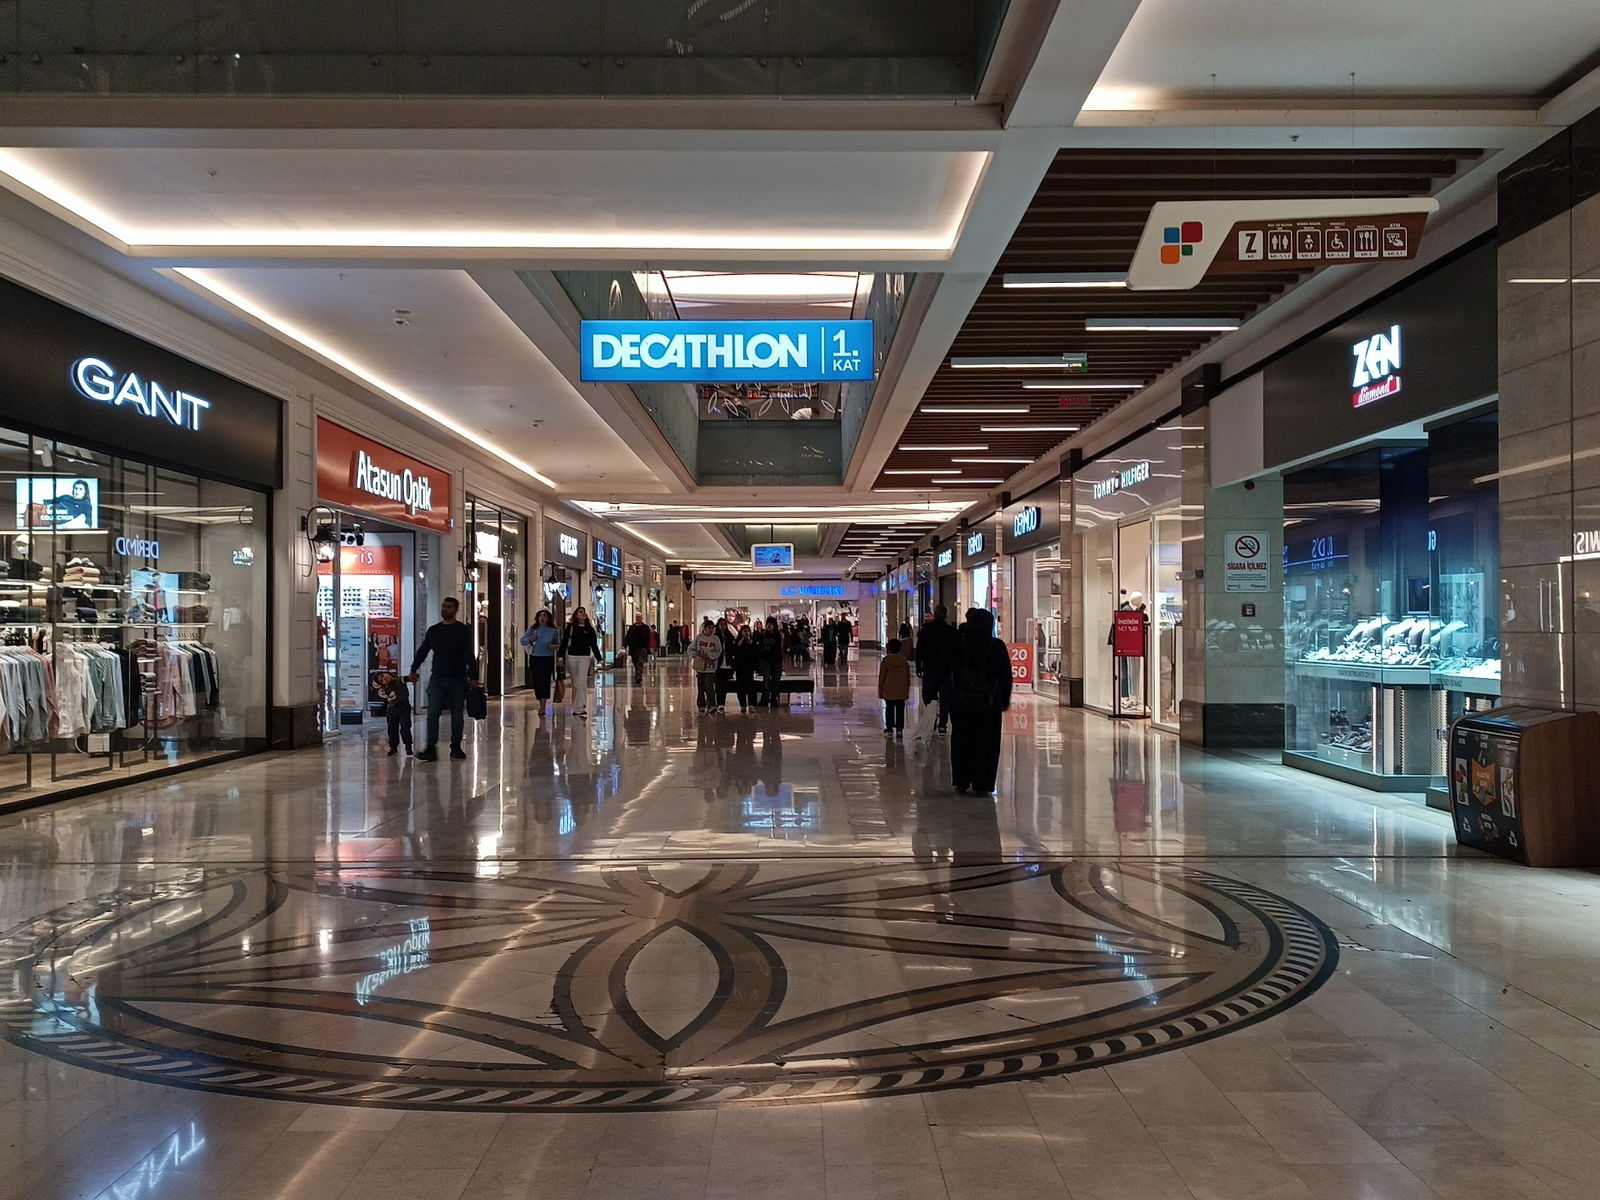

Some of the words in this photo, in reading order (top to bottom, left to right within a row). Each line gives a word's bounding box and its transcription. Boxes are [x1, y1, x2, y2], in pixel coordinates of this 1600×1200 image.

[1245, 233, 1257, 254] Z
[592, 333, 808, 369] DECATHLON
[833, 330, 859, 357] 1.
[1353, 325, 1401, 388] ZEN
[833, 359, 861, 372] KAT
[72, 357, 210, 432] GANT
[355, 450, 401, 502] Atasun
[403, 469, 433, 515] Optik
[1093, 477, 1115, 500] TOMMY
[1121, 462, 1150, 489] HILFIGER
[1010, 648, 1028, 661] 20
[1011, 665, 1027, 678] 50
